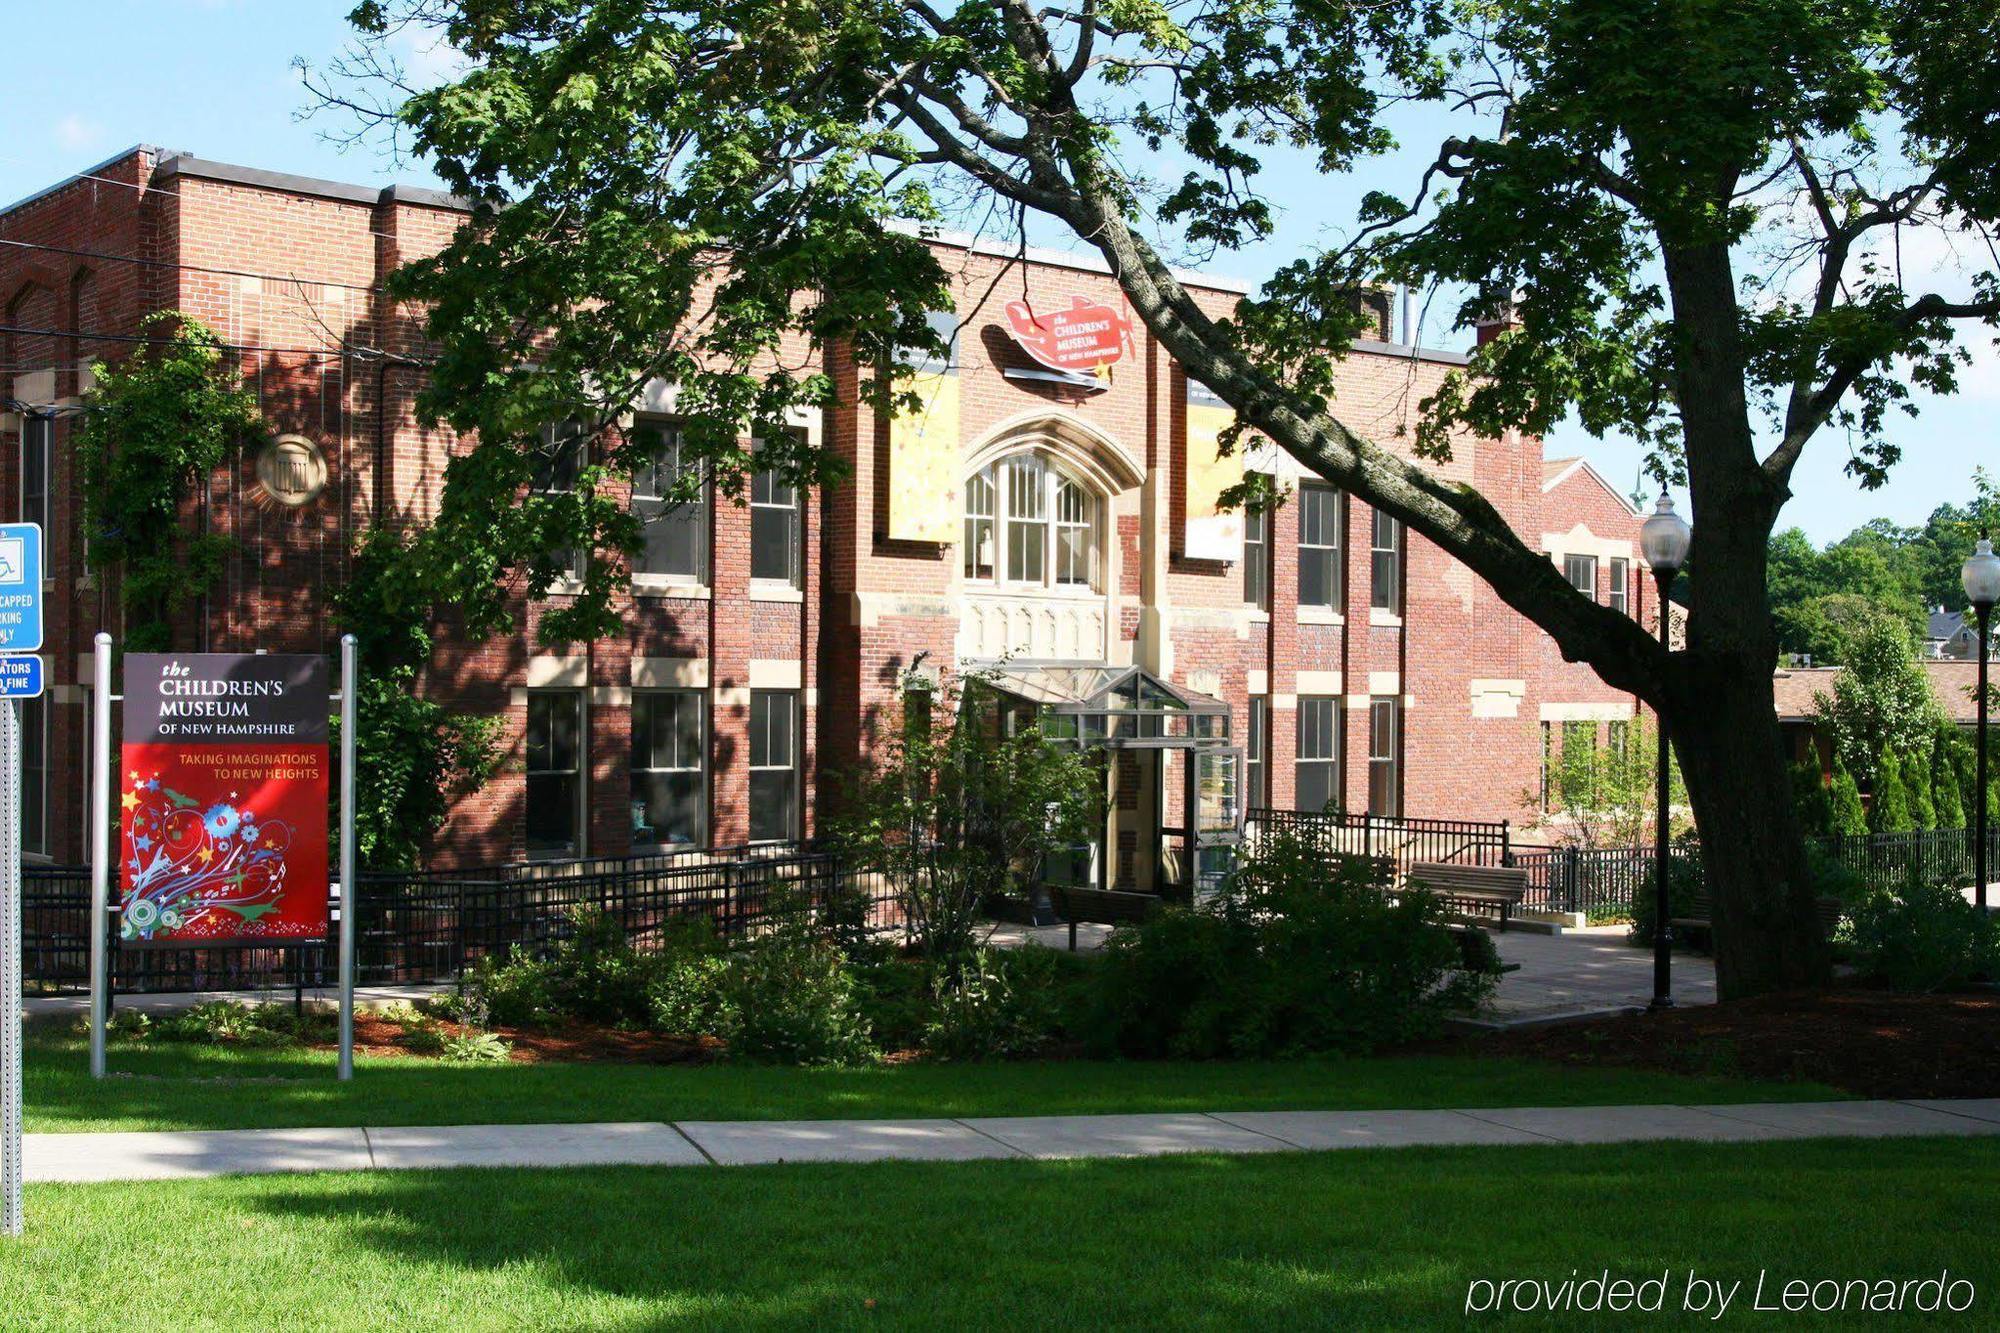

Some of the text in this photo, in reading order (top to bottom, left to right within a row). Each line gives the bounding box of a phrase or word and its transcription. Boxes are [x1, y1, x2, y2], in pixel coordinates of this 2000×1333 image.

[1056, 336, 1098, 350] MUSEUM
[161, 661, 191, 677] the
[7, 677, 29, 688] FINE
[159, 679, 284, 697] CHILDREN'S
[159, 701, 250, 717] MUSEUM
[158, 723, 296, 735] OF NEW HAMPSHIRE
[180, 754, 317, 765] TAKING IMAGINATIONS
[214, 768, 320, 780] TO NEW HEIGHTS
